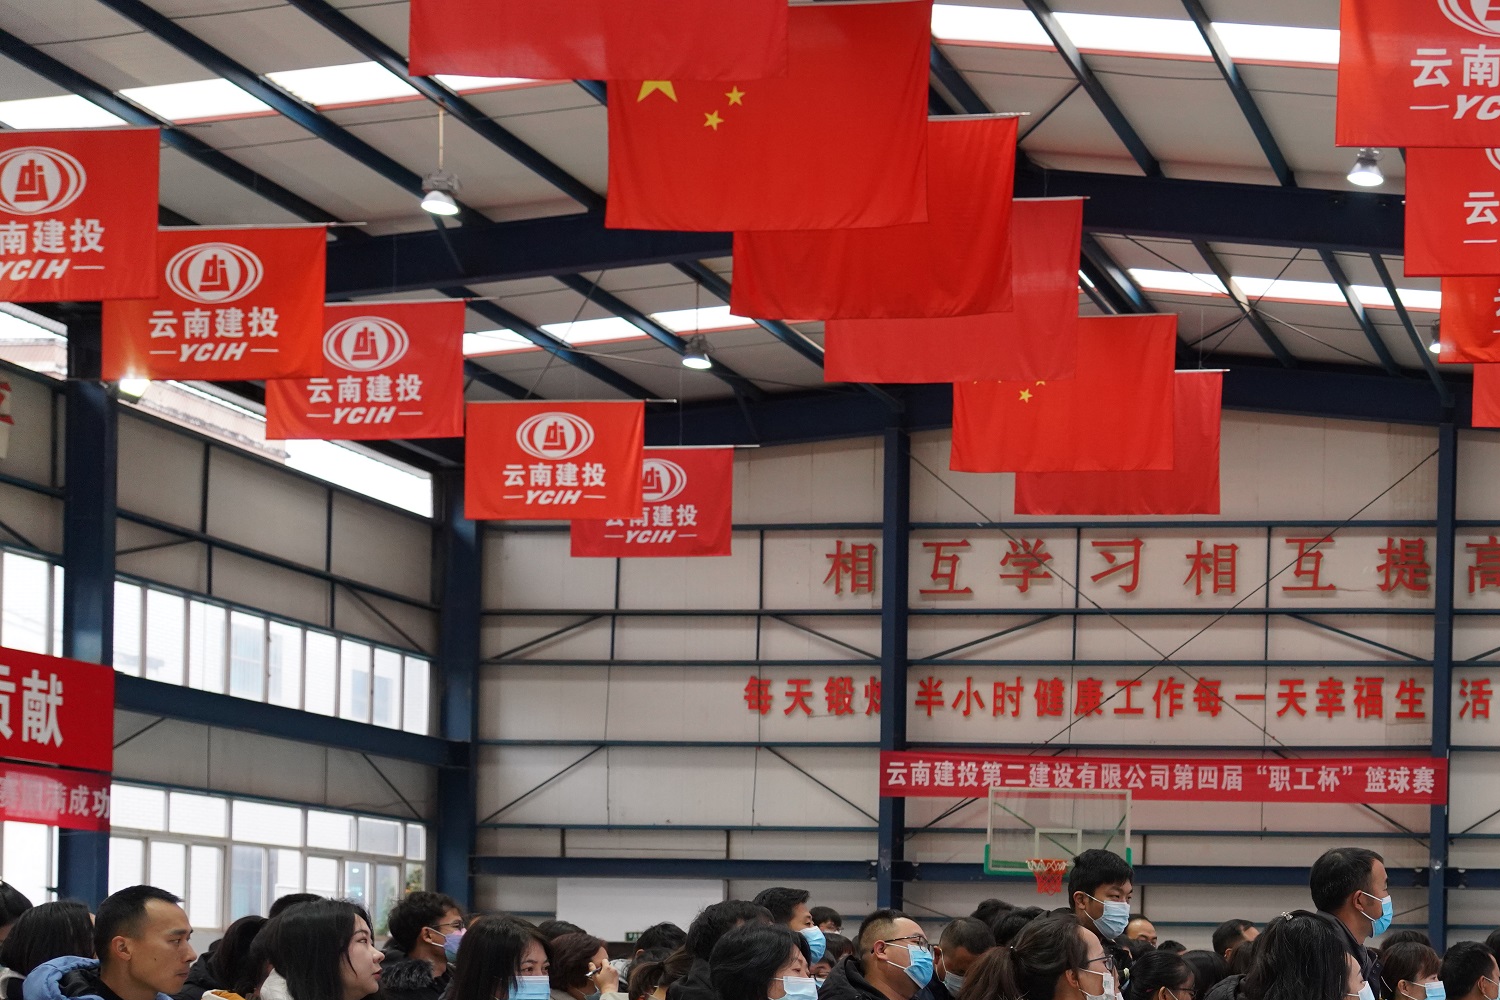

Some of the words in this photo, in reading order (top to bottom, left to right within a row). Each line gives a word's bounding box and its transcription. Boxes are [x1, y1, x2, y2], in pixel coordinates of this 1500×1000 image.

[149, 307, 278, 339] 云南建投
[180, 342, 248, 362] YCIH
[306, 373, 422, 403] 云南建投
[332, 406, 396, 424] YCIH
[503, 462, 606, 487] 云南建投
[525, 490, 582, 504] YCIH
[625, 530, 676, 543] YCIH
